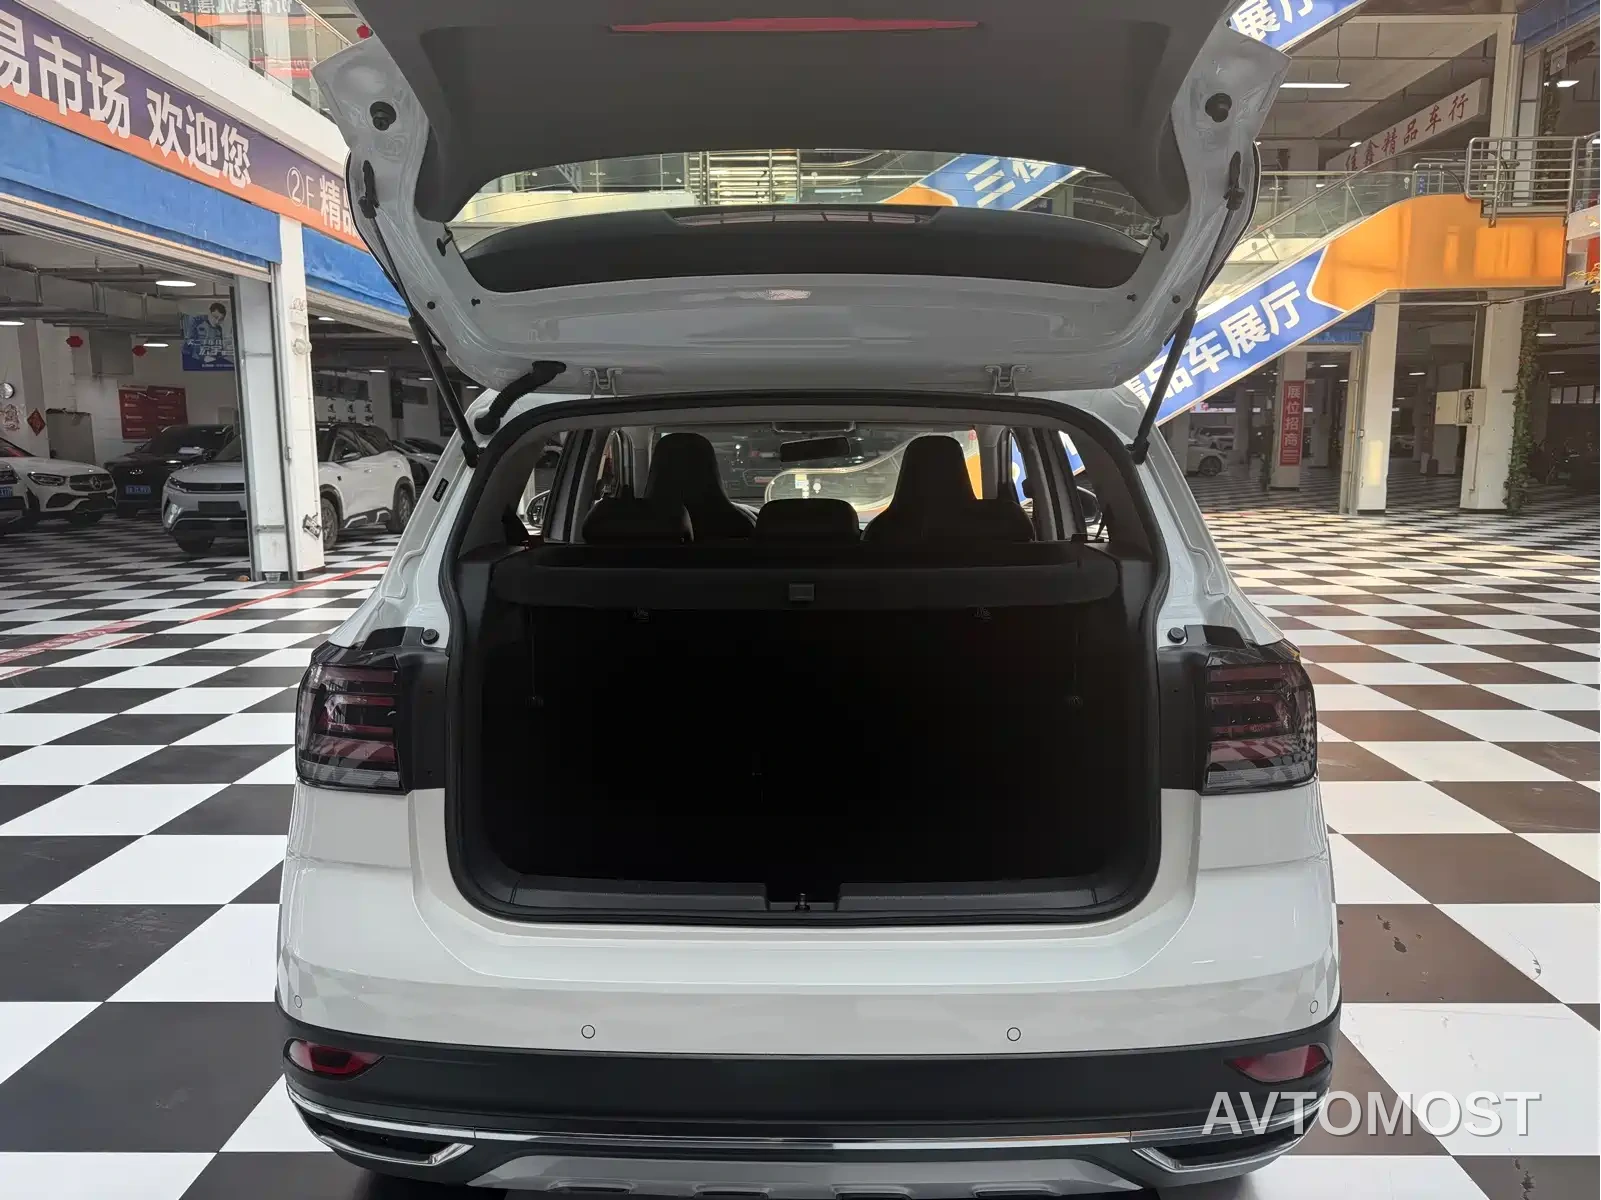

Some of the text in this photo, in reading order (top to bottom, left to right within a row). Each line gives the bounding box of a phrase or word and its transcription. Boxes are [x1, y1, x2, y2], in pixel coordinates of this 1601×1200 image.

[0, 9, 131, 139] 易市场
[146, 88, 251, 189] 欢迎您
[1284, 385, 1301, 447] 展位招商
